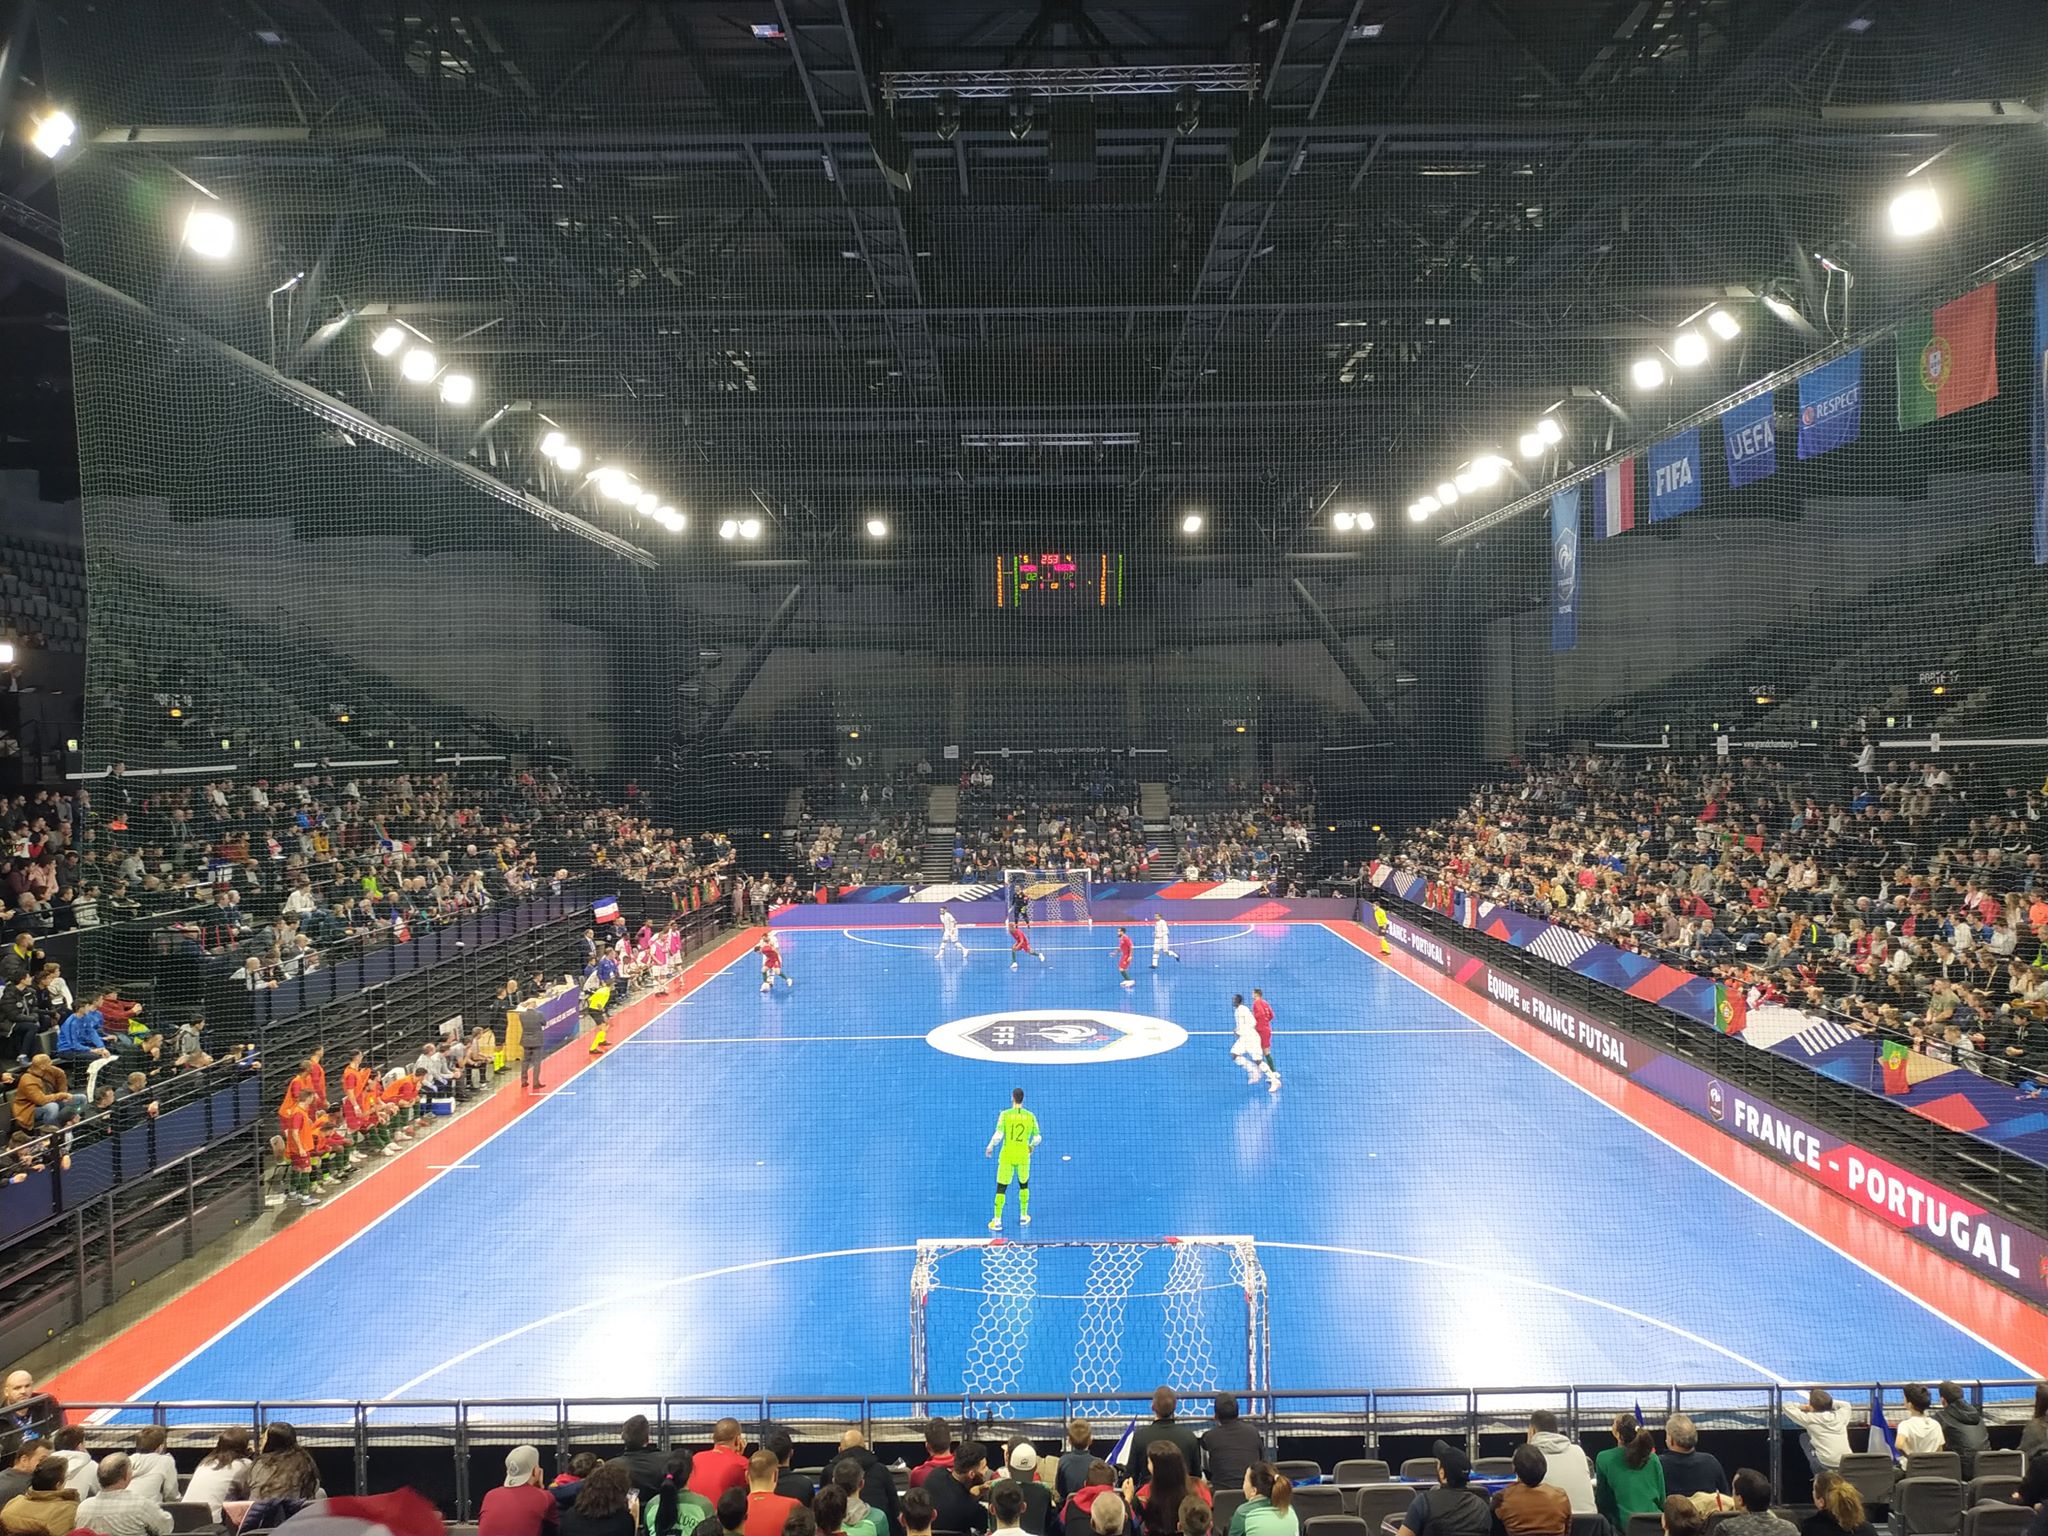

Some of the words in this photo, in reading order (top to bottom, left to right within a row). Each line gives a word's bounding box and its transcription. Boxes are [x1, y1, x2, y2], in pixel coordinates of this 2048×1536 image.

[1816, 387, 1859, 419] RESPECT
[1729, 421, 1774, 460] UEFA
[1656, 457, 1693, 497] FIFA
[1411, 933, 1444, 965] PORTUGAL
[992, 1026, 1015, 1045] FFF
[1487, 969, 1520, 1008] ÉQUIPE
[1521, 997, 1531, 1014] DE
[1532, 996, 1576, 1037] FRANCE
[1578, 1022, 1629, 1068] FUTSAL
[1010, 1123, 1026, 1142] 12
[1734, 1098, 1821, 1171] FRANCE
[1848, 1157, 2020, 1279] PORTUGAL
